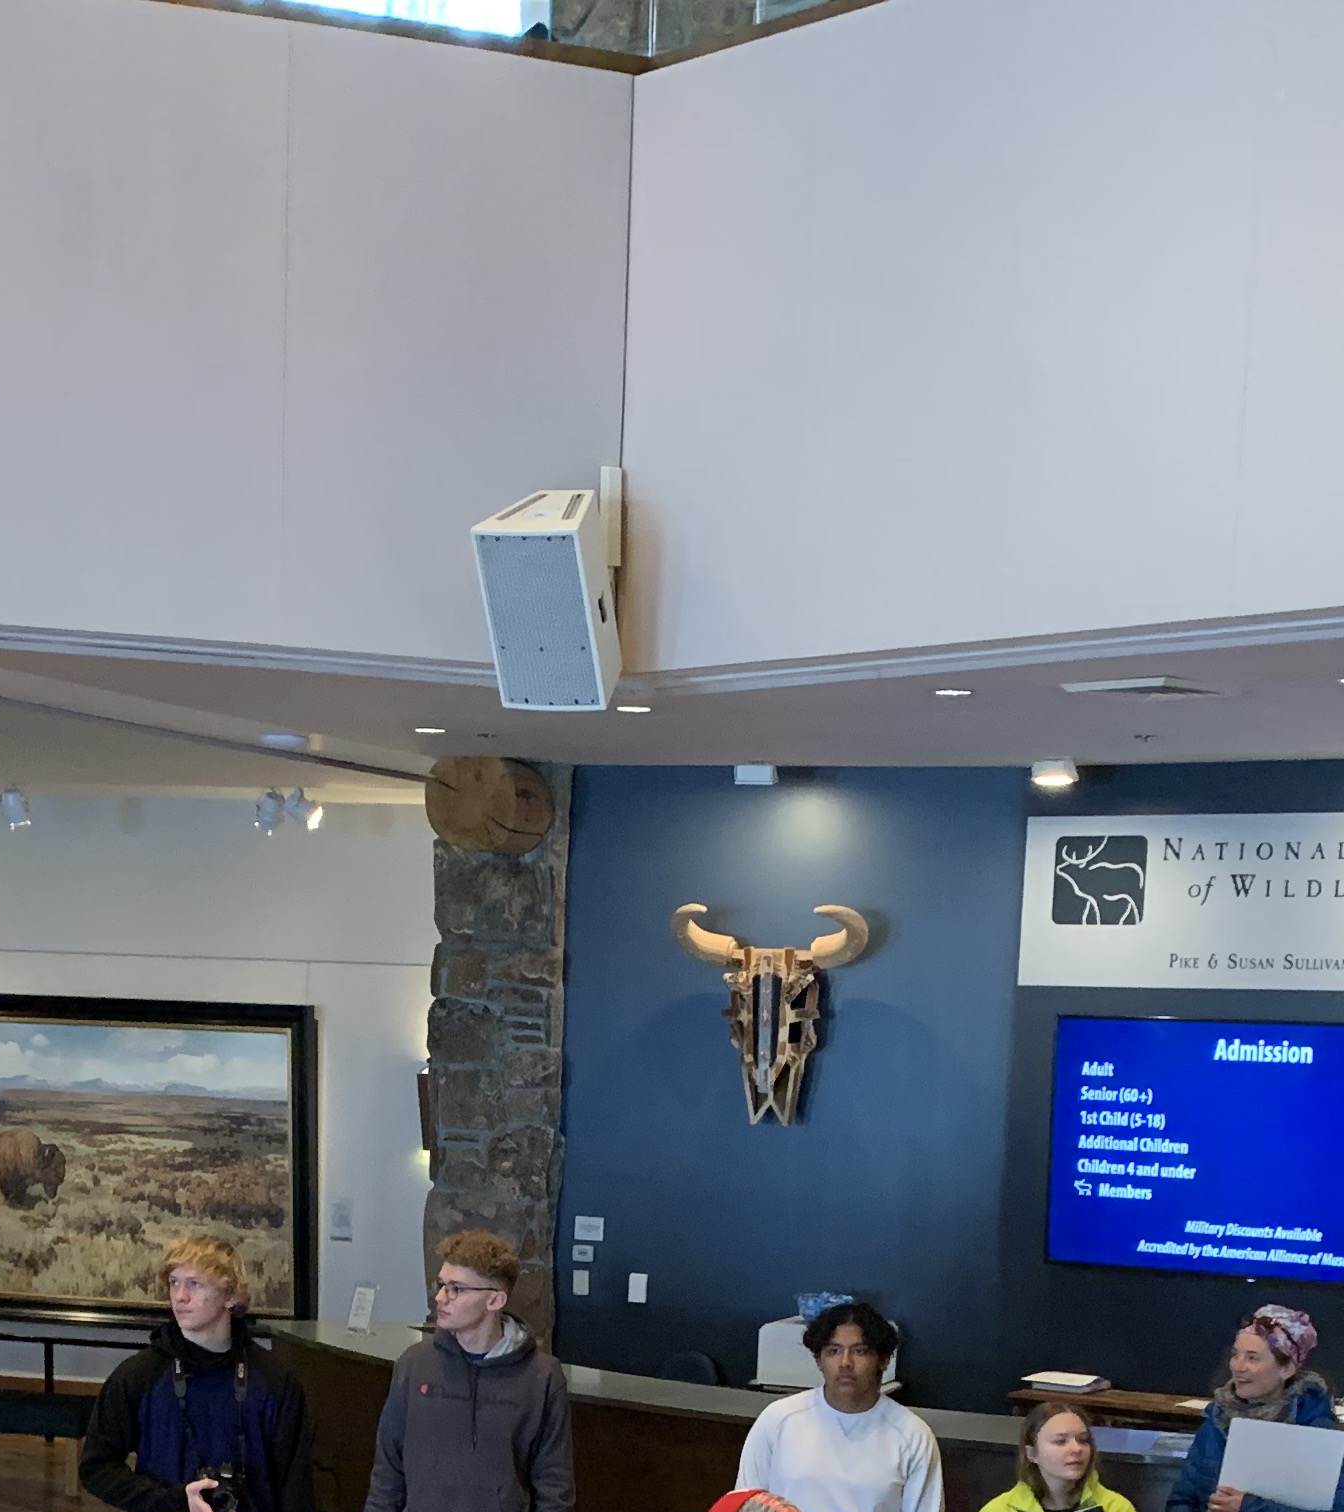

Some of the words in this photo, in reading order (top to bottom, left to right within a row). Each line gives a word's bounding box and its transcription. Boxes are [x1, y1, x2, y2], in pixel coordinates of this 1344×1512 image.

[1187, 874, 1218, 905] of
[1207, 954, 1219, 970] &
[1226, 953, 1275, 971] SUSAN
[1214, 1038, 1314, 1065] Admission
[1081, 1061, 1114, 1077] Adult
[1080, 1086, 1118, 1101] Senior
[1119, 1087, 1153, 1105] (60+)
[1080, 1111, 1097, 1125] 1st
[1099, 1111, 1128, 1127] Child
[1130, 1112, 1166, 1130] (5-18)
[1078, 1135, 1138, 1151] Additional
[1140, 1138, 1189, 1154] Children
[1077, 1158, 1125, 1175] Children
[1127, 1162, 1135, 1175] 4
[1136, 1163, 1159, 1178] and
[1160, 1164, 1197, 1179] under
[1098, 1183, 1152, 1200] Members
[1185, 1220, 1224, 1238] Military
[1226, 1223, 1274, 1239] Discounts
[1274, 1226, 1323, 1242] Available
[1137, 1239, 1187, 1256] Accredited
[1188, 1243, 1201, 1259] by
[1202, 1244, 1219, 1258] the
[1220, 1246, 1267, 1262] American
[1267, 1249, 1309, 1265] Alliance
[1309, 1252, 1322, 1265] of
